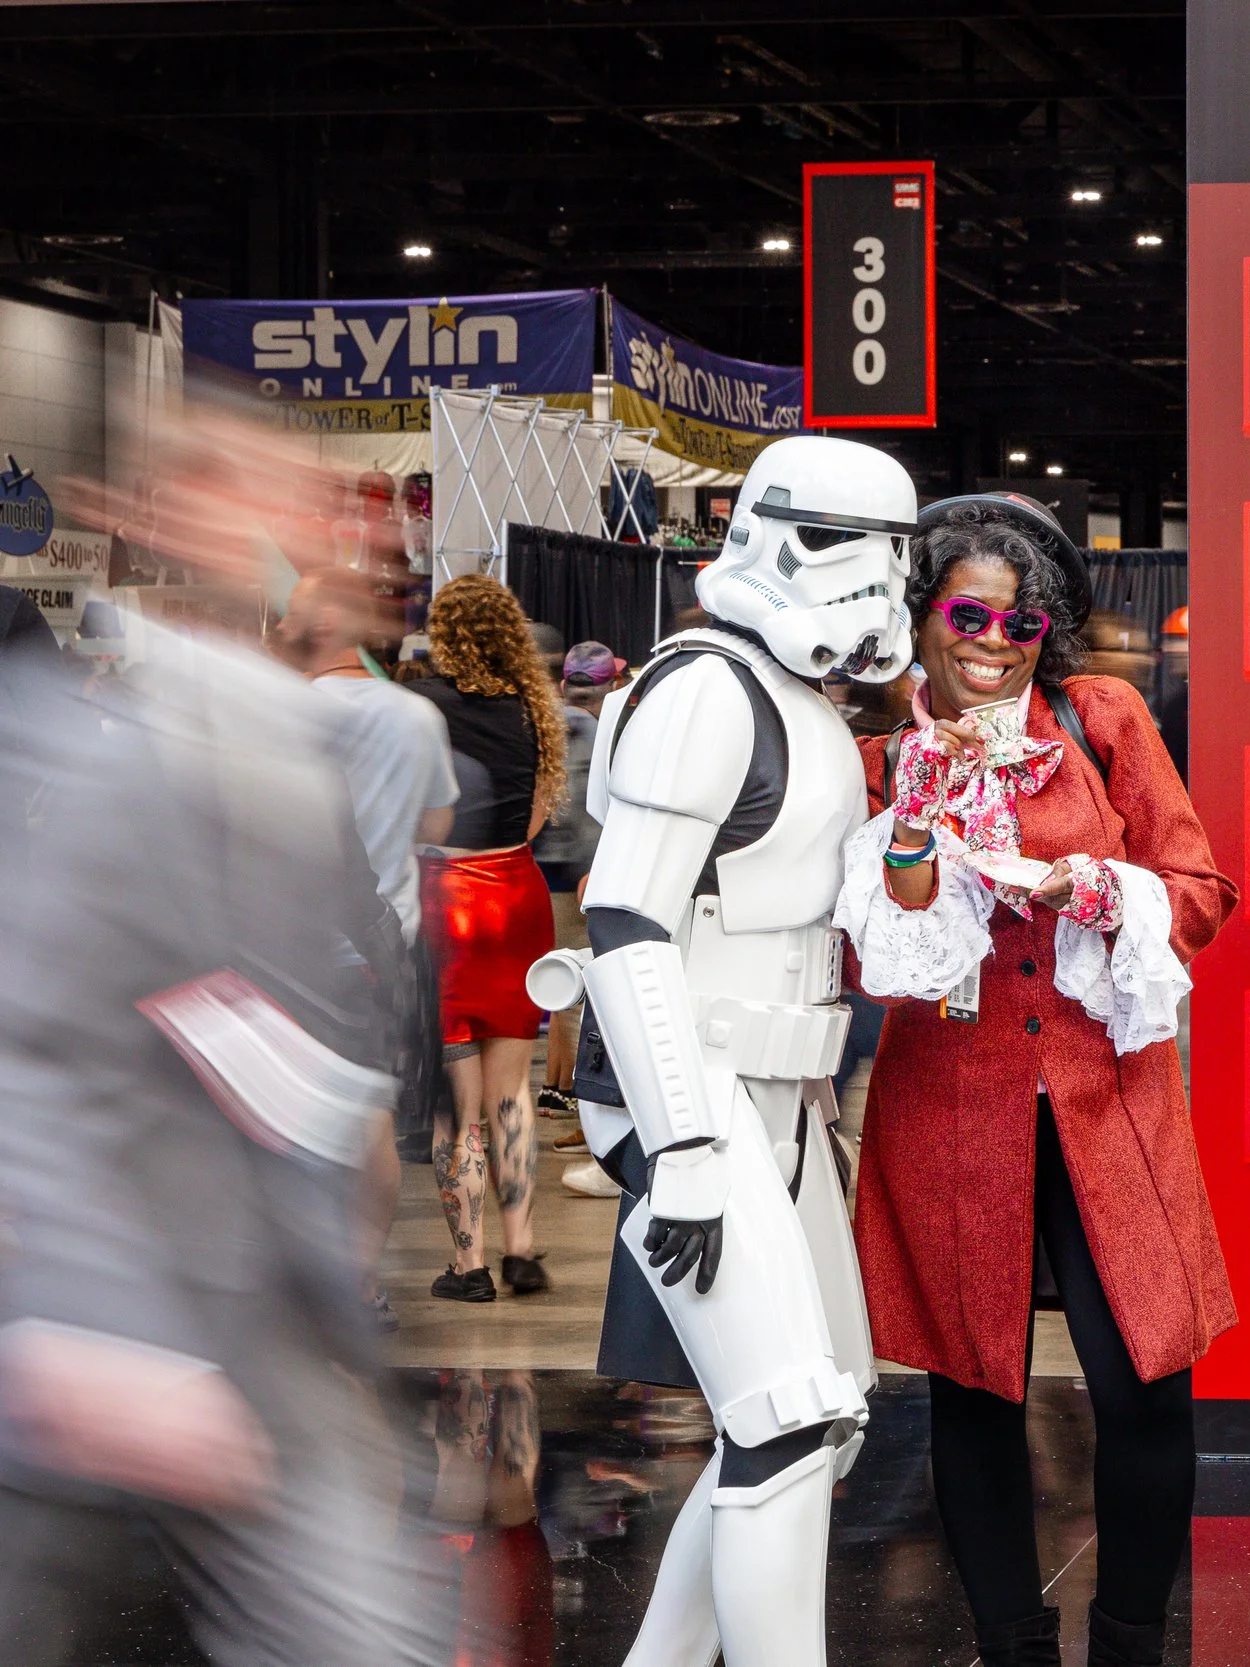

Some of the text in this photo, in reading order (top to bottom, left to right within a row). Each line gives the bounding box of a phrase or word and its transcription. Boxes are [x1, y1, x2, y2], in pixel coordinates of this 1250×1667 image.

[252, 298, 519, 385] stylin
[852, 236, 886, 386] 300
[41, 590, 73, 609] CLAIM
